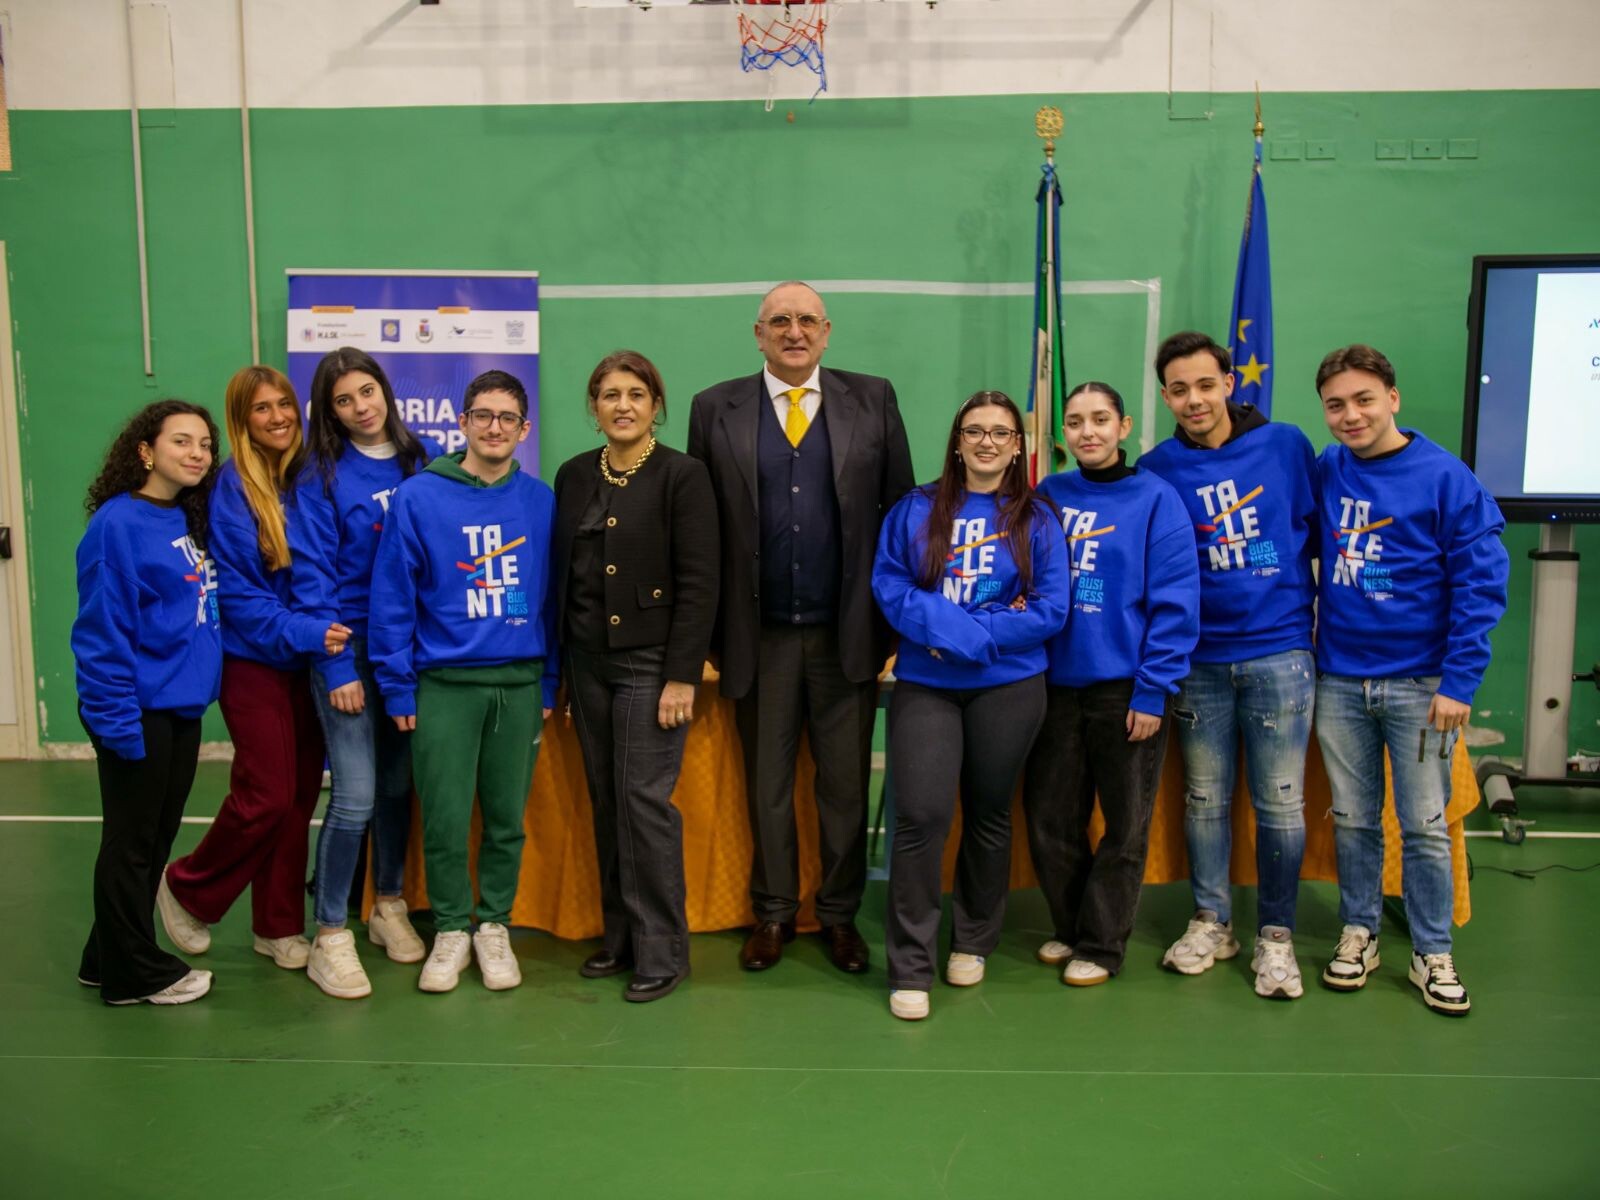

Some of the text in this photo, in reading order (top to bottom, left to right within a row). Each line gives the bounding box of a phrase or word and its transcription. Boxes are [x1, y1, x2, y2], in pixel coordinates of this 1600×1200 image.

[1195, 479, 1240, 518] TA
[1339, 496, 1372, 530] TA
[1223, 506, 1261, 542] LE
[462, 524, 503, 557] TA
[1208, 540, 1247, 572] NT
[1346, 531, 1384, 562] LE
[485, 555, 520, 587] LE
[962, 545, 996, 577] LE
[1249, 551, 1279, 568] NESS
[1332, 553, 1366, 589] NT
[942, 574, 978, 606] NT
[1075, 589, 1104, 604] NESS
[1363, 578, 1394, 591] NESS
[466, 586, 506, 619] NT
